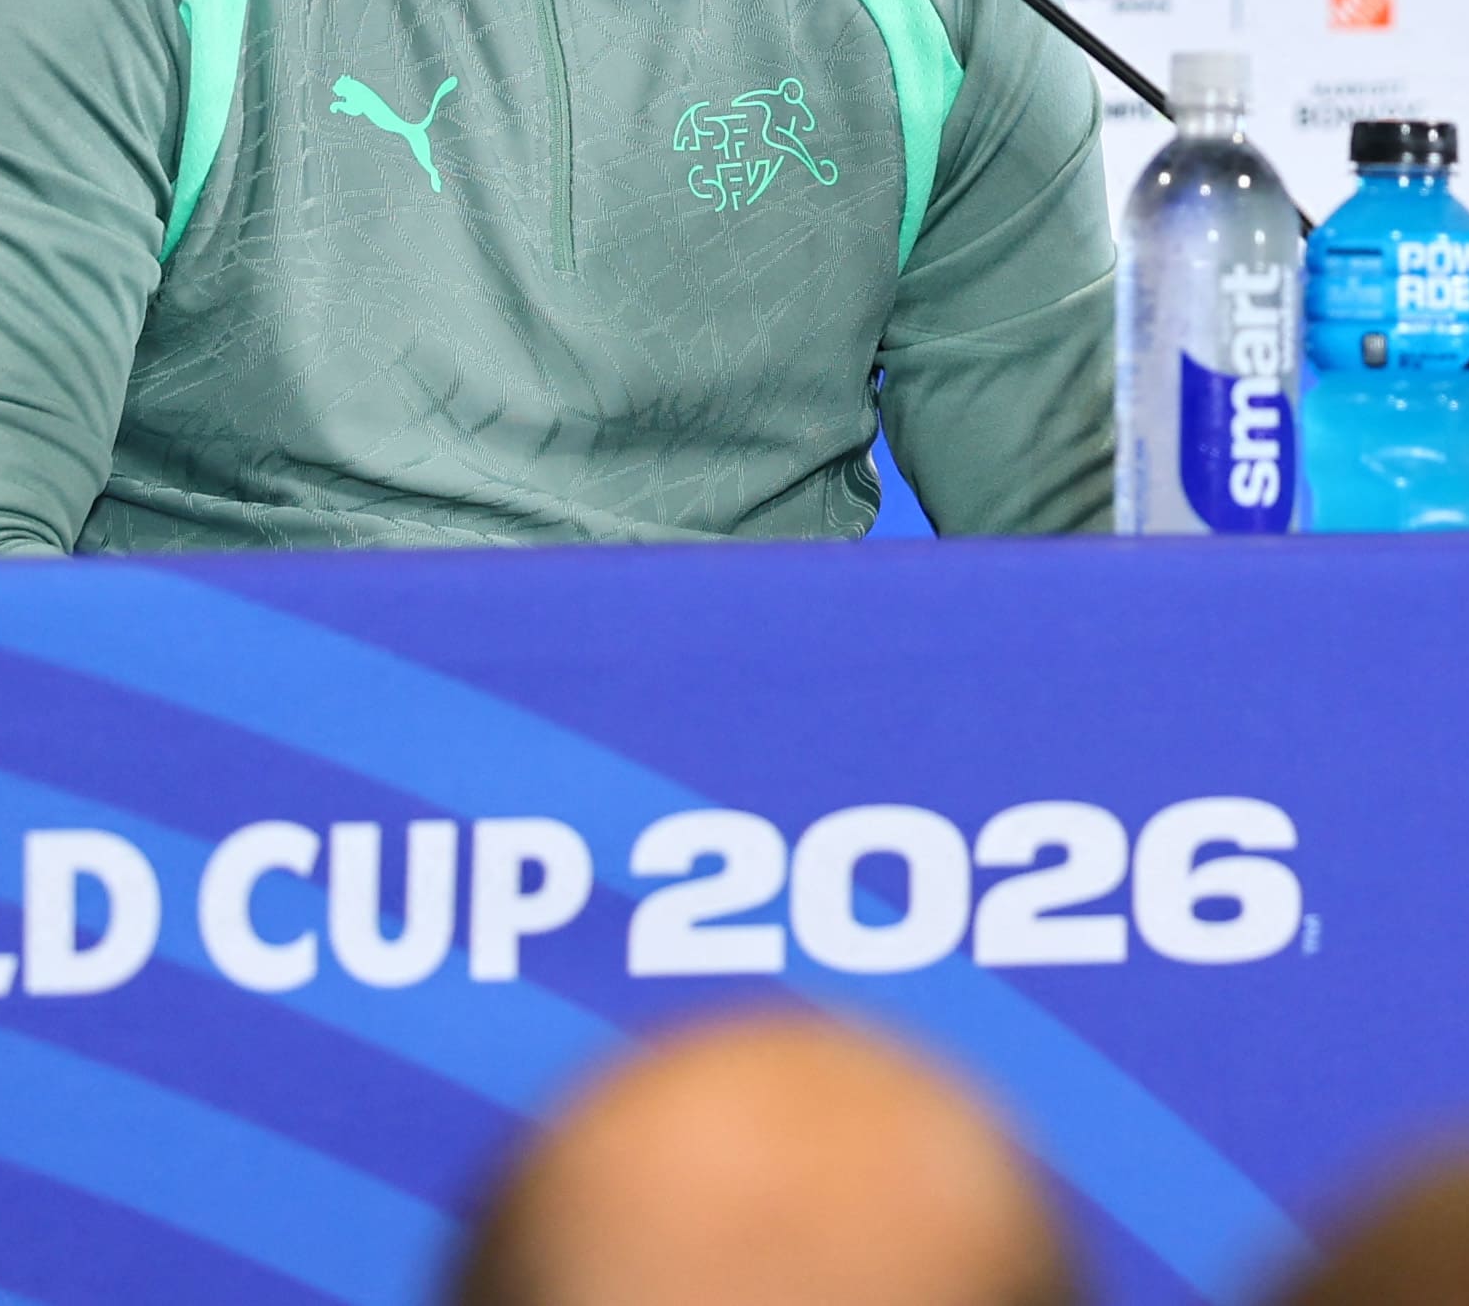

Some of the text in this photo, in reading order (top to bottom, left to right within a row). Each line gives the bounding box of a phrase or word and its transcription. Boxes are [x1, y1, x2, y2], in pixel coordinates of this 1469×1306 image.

[1222, 263, 1280, 508] smart
[197, 816, 594, 993] CUP
[626, 796, 1303, 978] 2026
